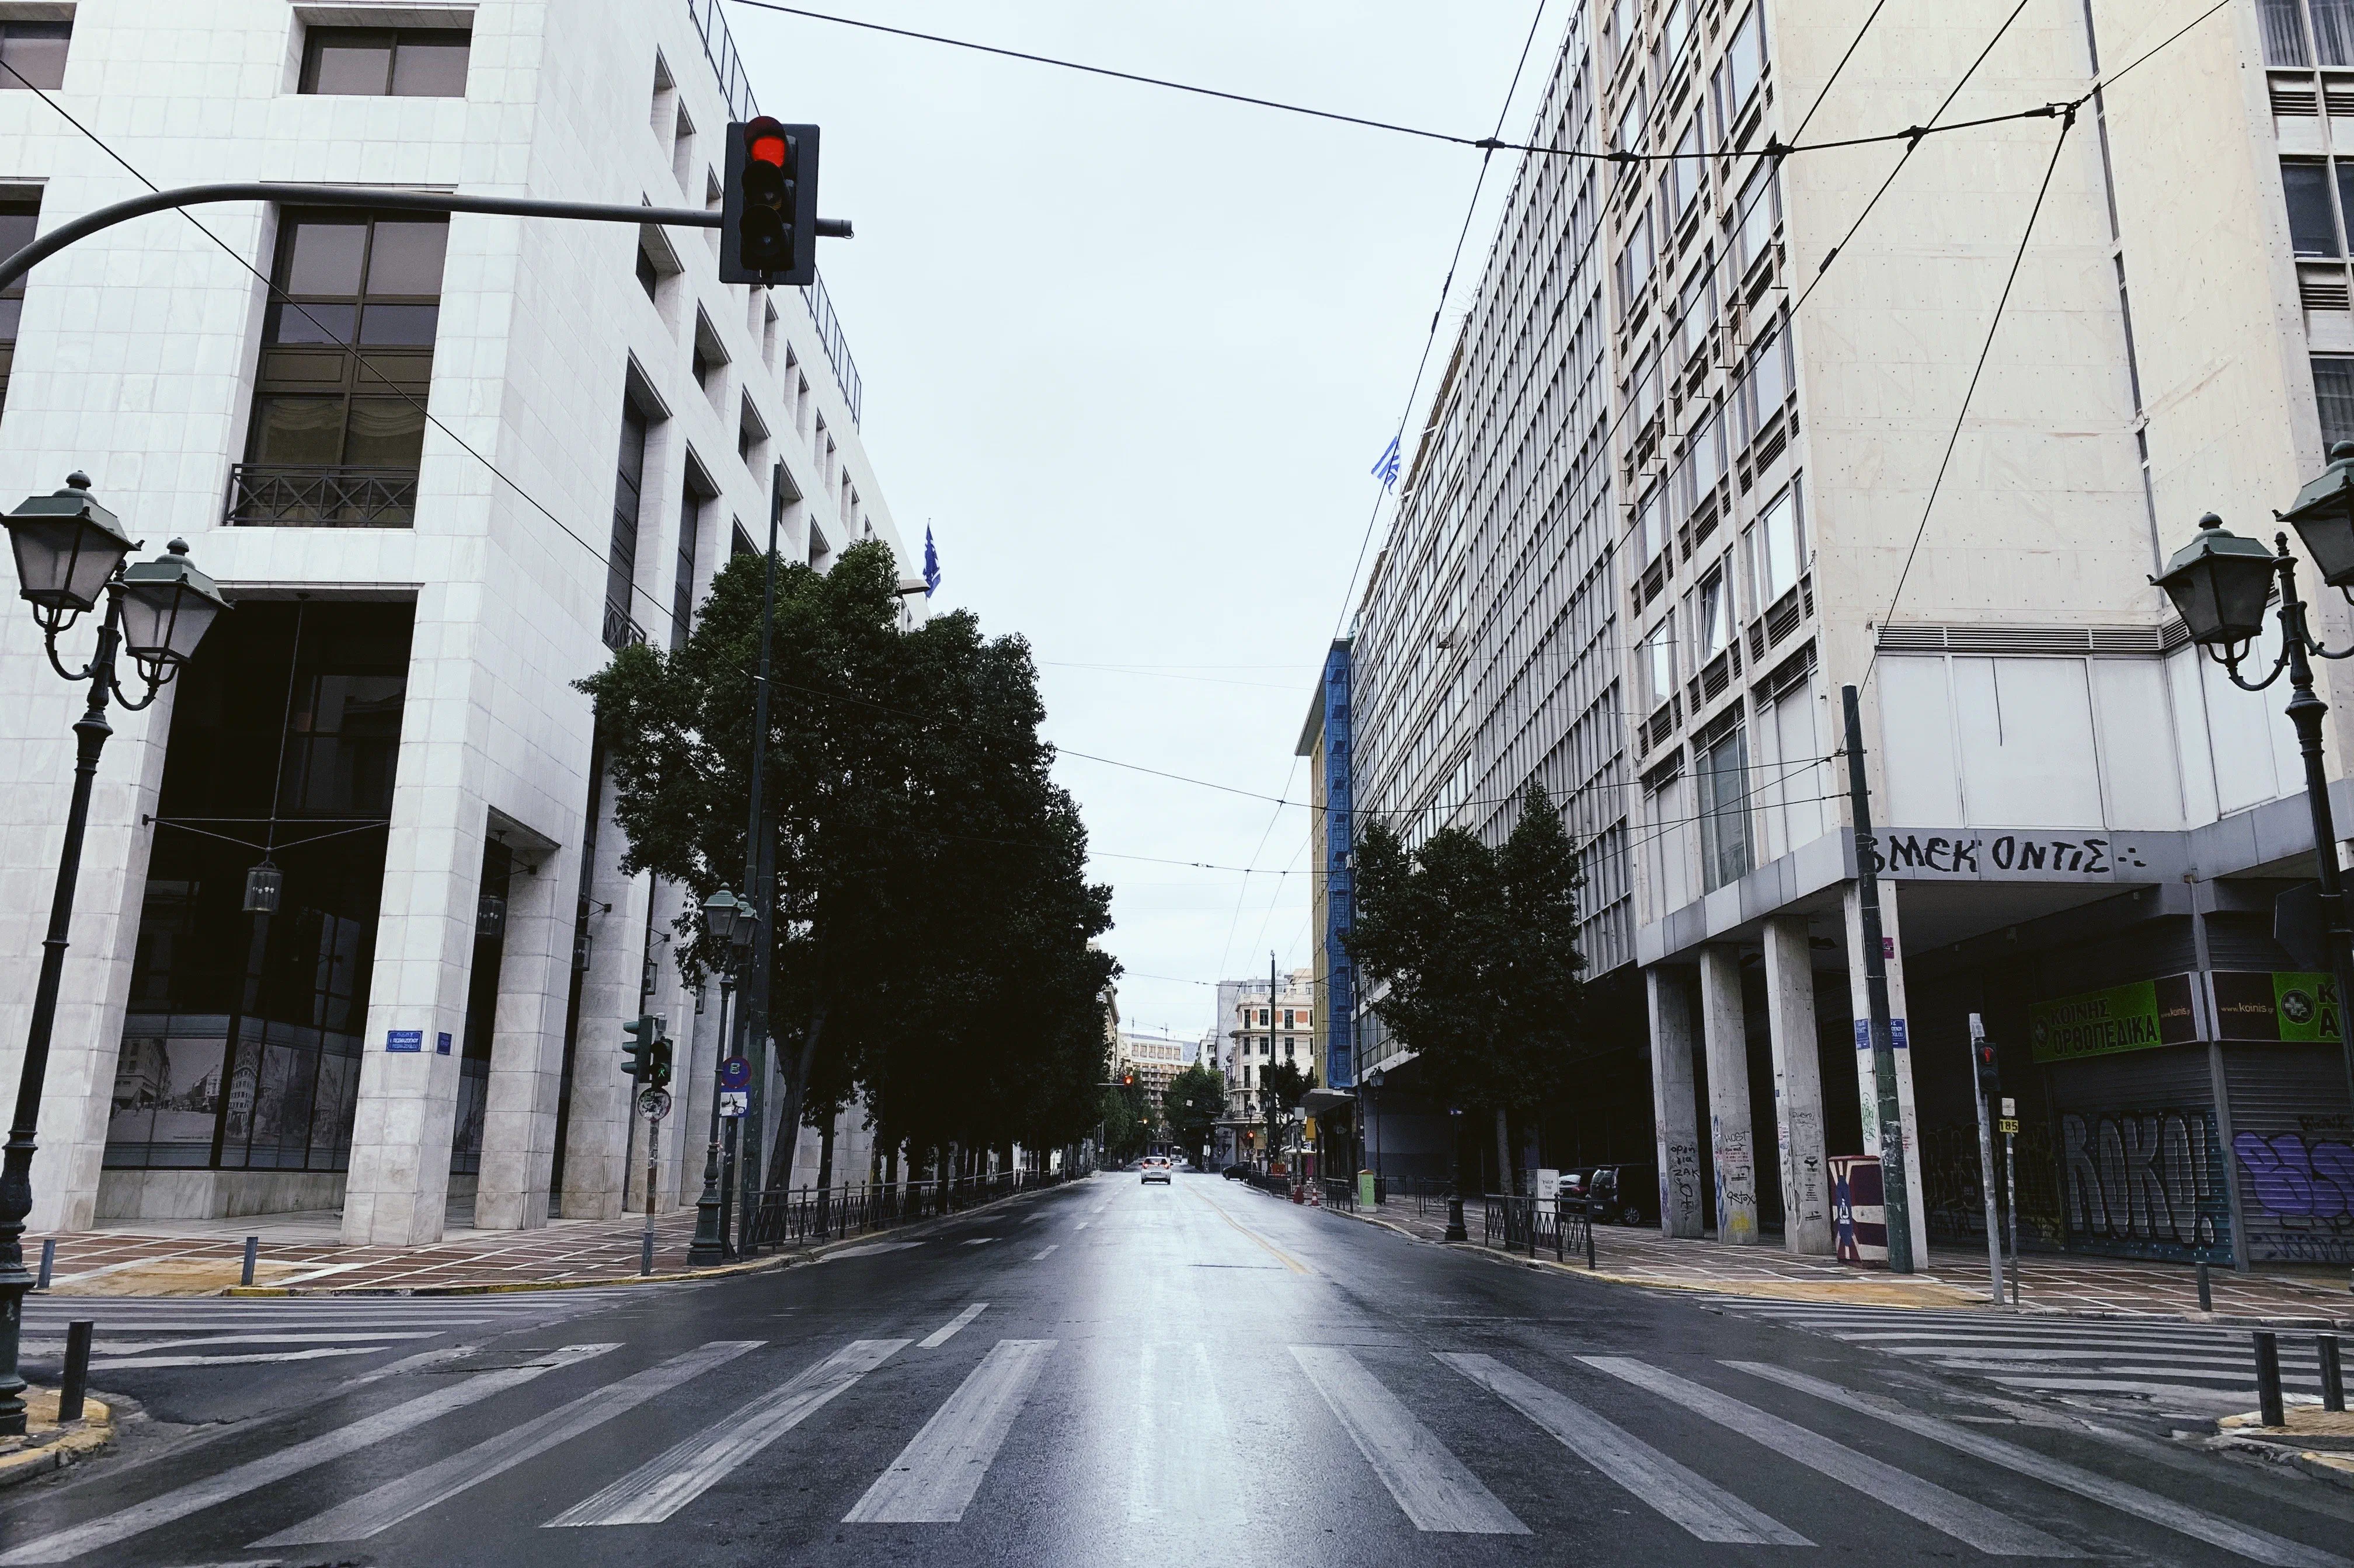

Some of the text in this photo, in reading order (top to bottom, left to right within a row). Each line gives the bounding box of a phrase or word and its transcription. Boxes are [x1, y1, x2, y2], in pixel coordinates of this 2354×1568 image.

[2049, 998, 2111, 1026] ΚΟΙΝΗΣ
[2221, 1002, 2275, 1014] www.koinis.gr
[2053, 1013, 2158, 1055] ΟΡΘΟΠΕΔΙΚΑ
[2001, 1121, 2018, 1131] 185
